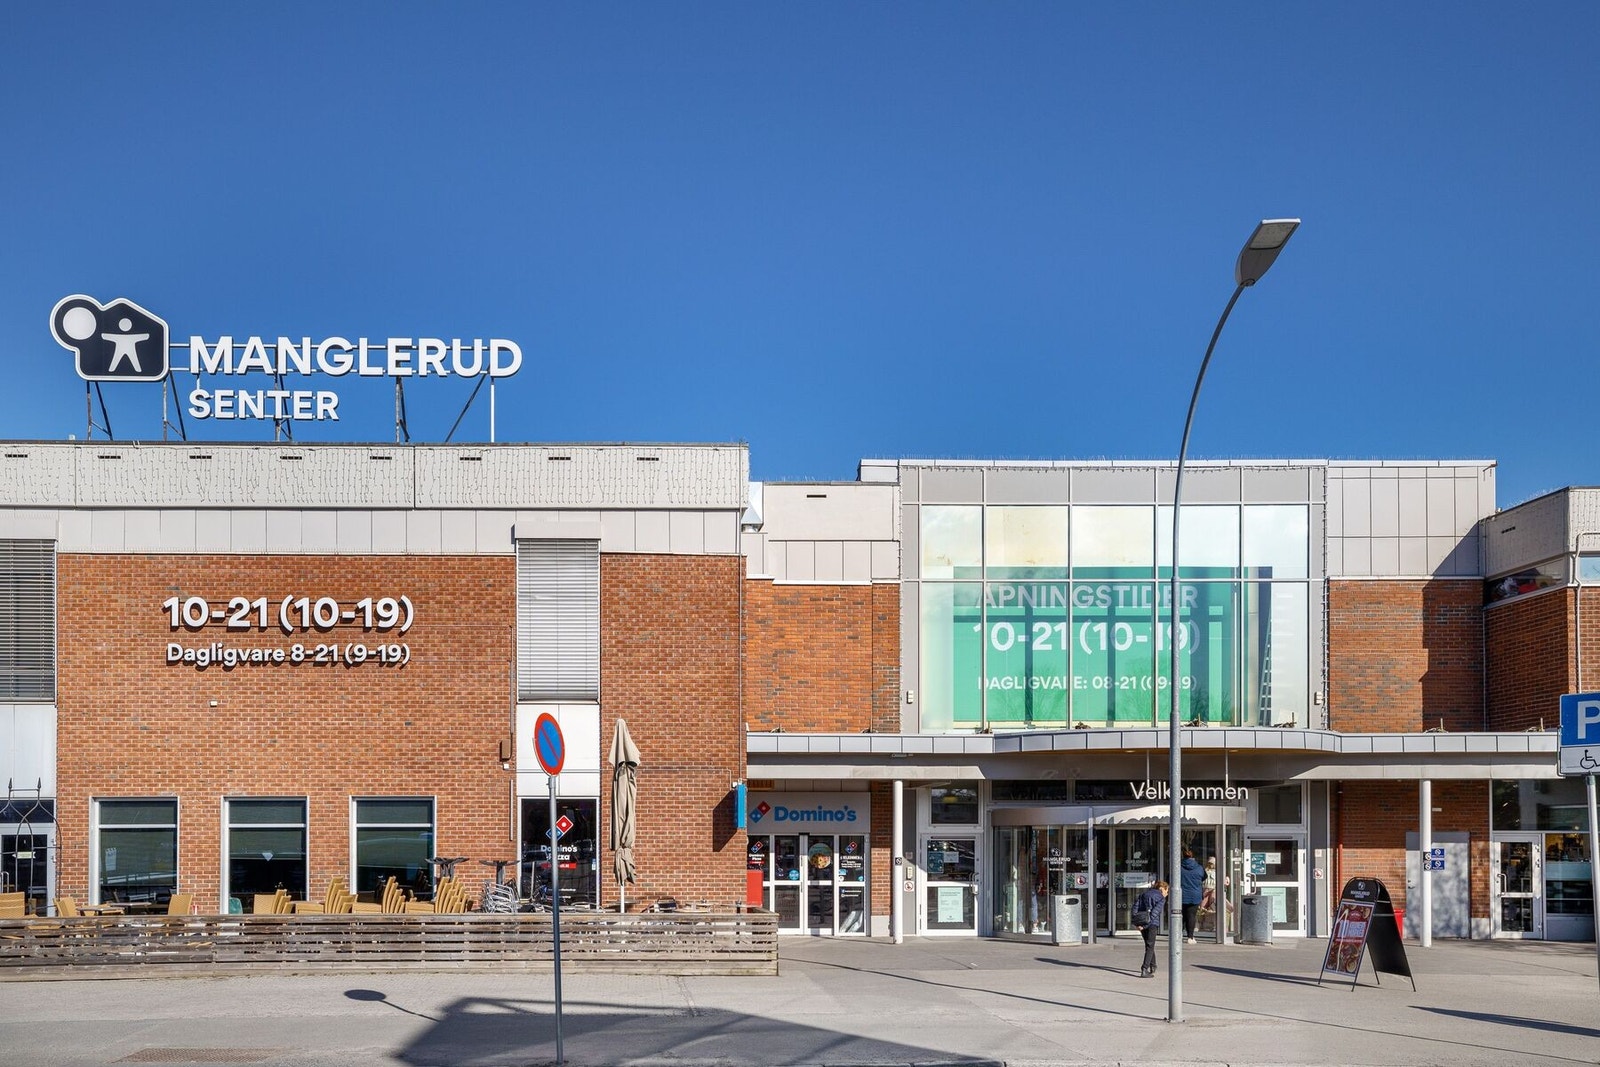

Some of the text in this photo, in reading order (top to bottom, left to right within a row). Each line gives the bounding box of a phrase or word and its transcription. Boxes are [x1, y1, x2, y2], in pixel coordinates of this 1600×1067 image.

[189, 335, 523, 377] MANGLERUD
[188, 388, 340, 421] SENTER
[162, 594, 415, 633] 10-21 (10-19)
[166, 642, 411, 667] Dagligvare 8-21 (9-19)
[1091, 675, 1137, 690] 08-21
[1140, 674, 1197, 691] (9-9)
[1577, 700, 1600, 739] P
[774, 805, 857, 822] Domino's
[540, 844, 577, 853] Doino's
